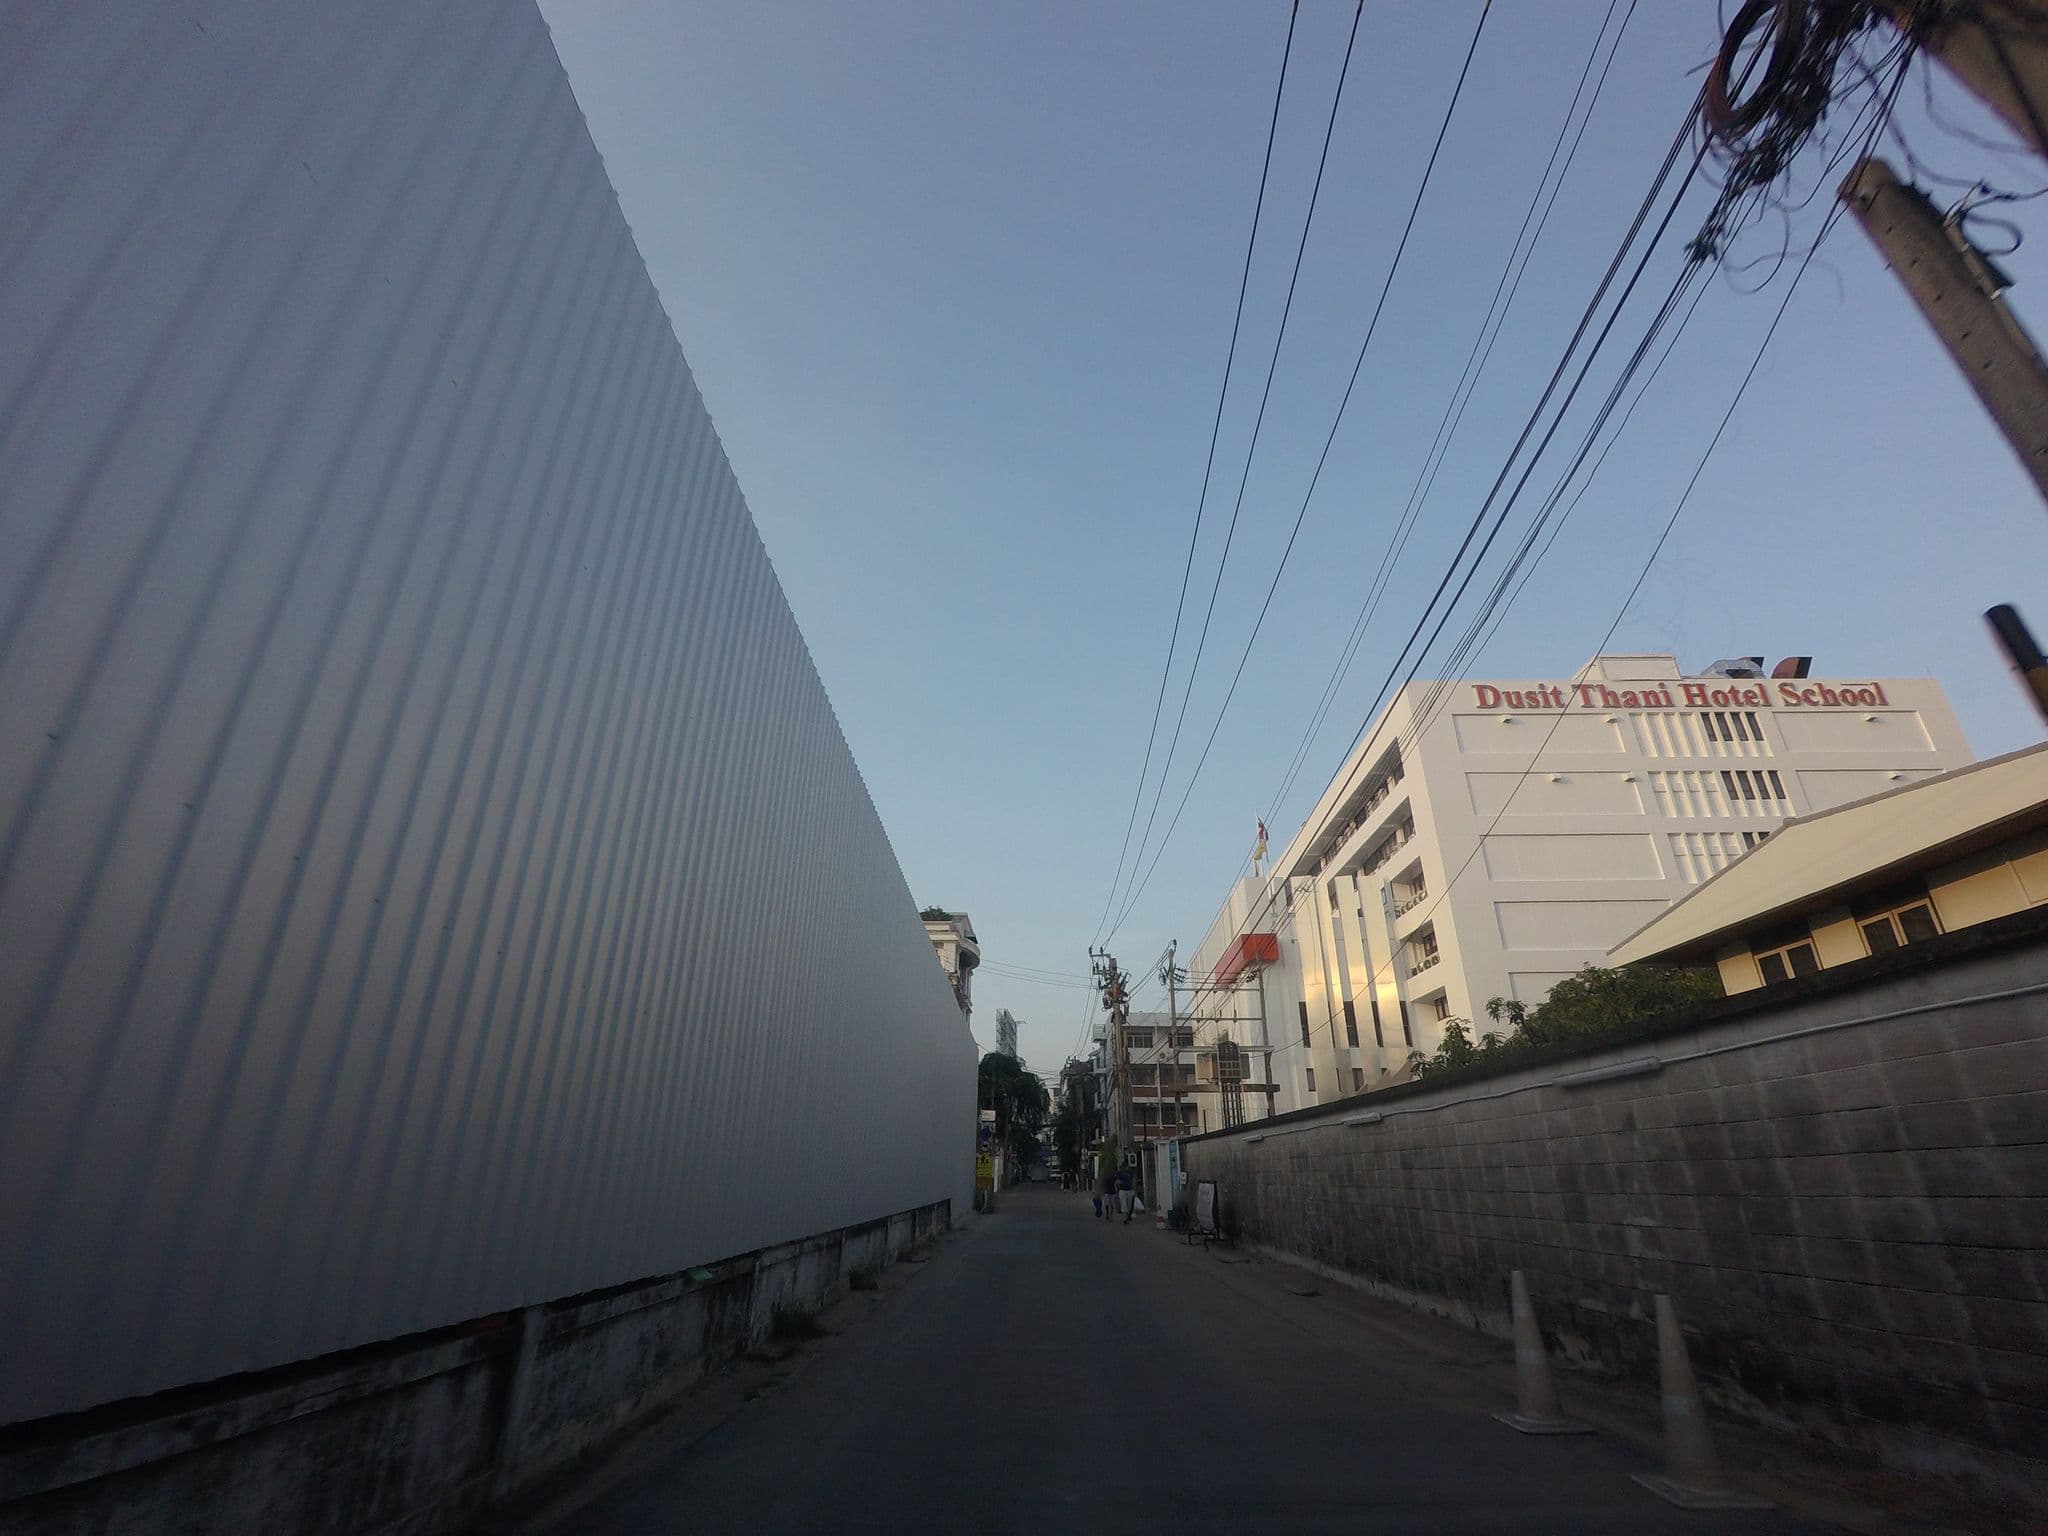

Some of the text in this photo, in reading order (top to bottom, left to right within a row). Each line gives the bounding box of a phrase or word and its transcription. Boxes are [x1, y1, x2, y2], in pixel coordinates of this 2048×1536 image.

[1473, 681, 1888, 708] Dusit Thani Hotel School
